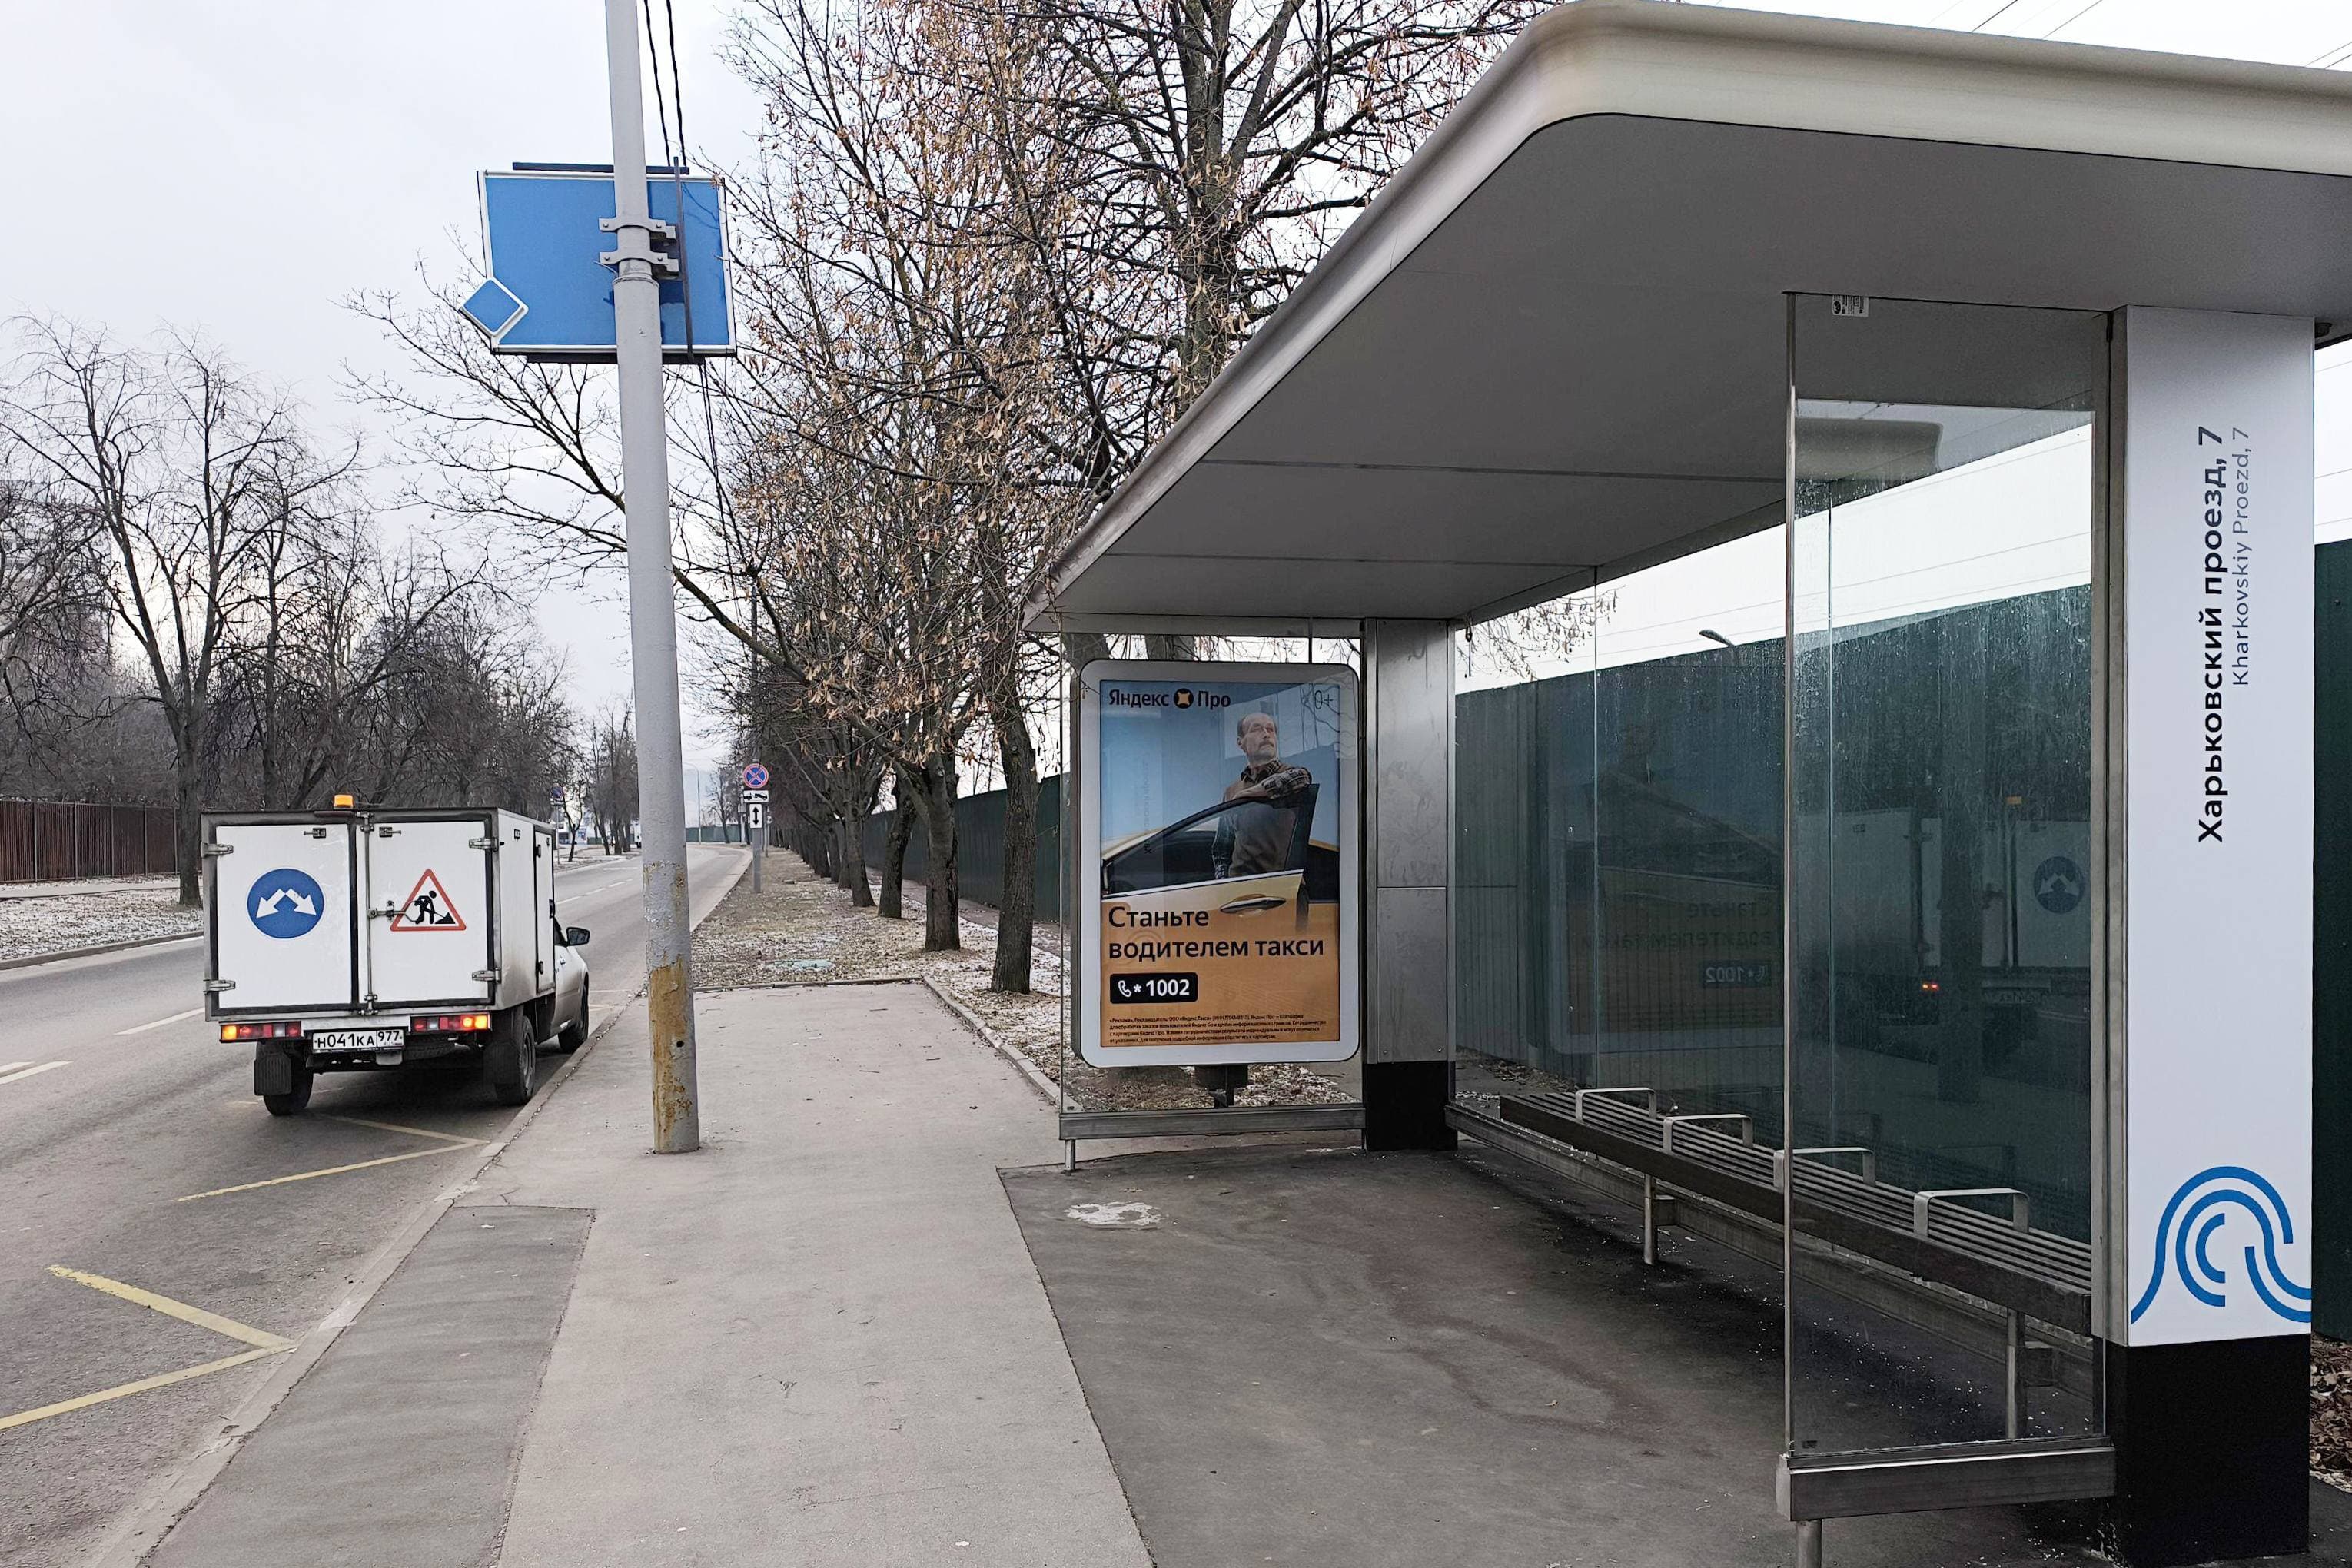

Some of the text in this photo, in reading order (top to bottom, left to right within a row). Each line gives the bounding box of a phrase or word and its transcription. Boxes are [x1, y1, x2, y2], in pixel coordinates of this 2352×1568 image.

[2231, 427, 2252, 685] Kharkovskiy Proezd, 7
[2198, 425, 2228, 843] Харьковский проезд, 7
[1108, 689, 1231, 710] Яндекс Про
[1108, 906, 1209, 927] Станьте
[1108, 939, 1324, 962] водителем такси
[377, 1031, 400, 1041] 977
